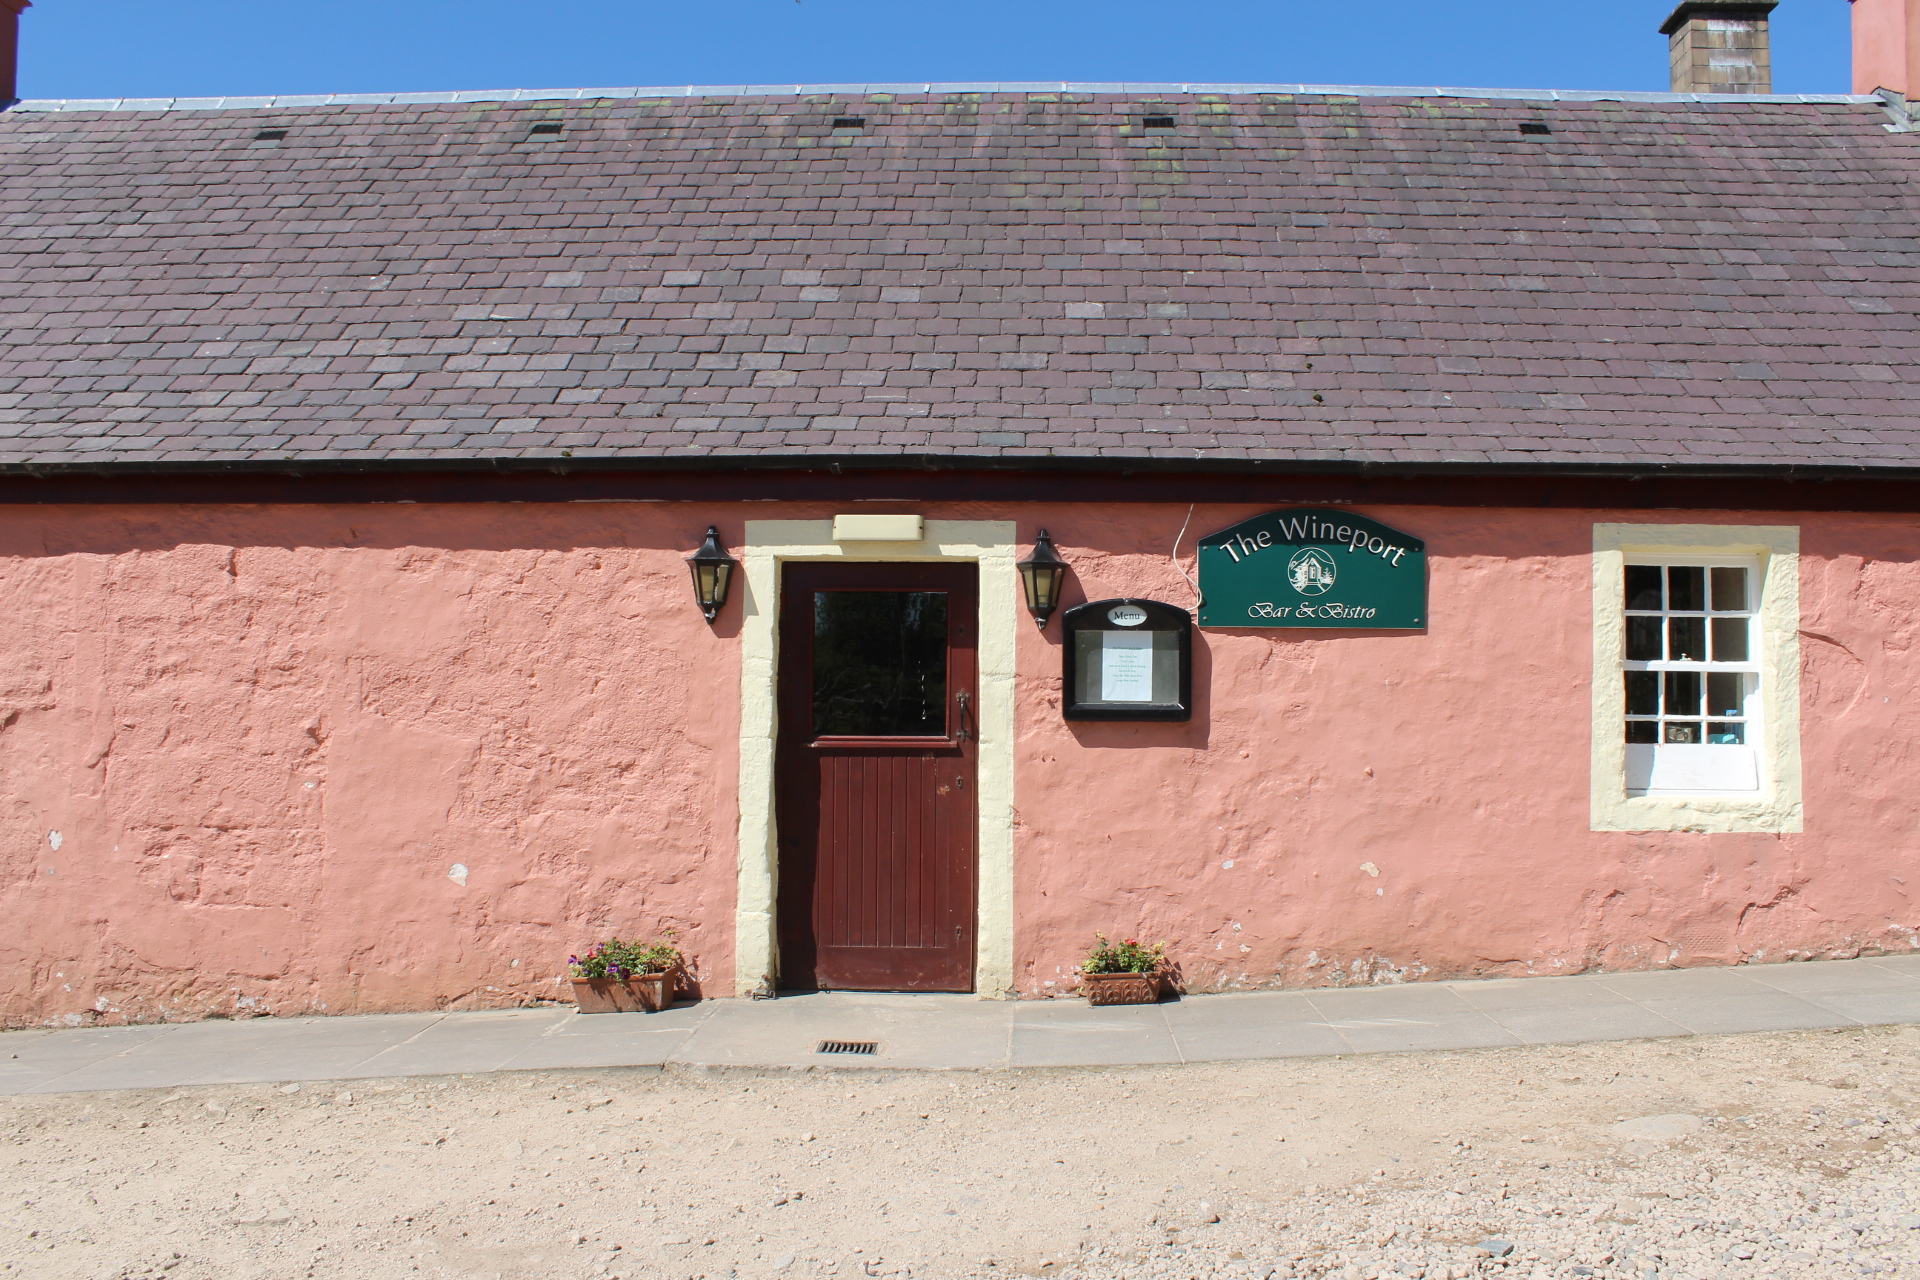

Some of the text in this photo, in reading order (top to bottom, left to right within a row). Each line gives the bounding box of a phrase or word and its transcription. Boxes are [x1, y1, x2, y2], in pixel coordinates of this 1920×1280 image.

[1219, 515, 1406, 567] The Wineport
[1114, 611, 1141, 620] Menu
[1248, 602, 1376, 619] Bar & Bistro
